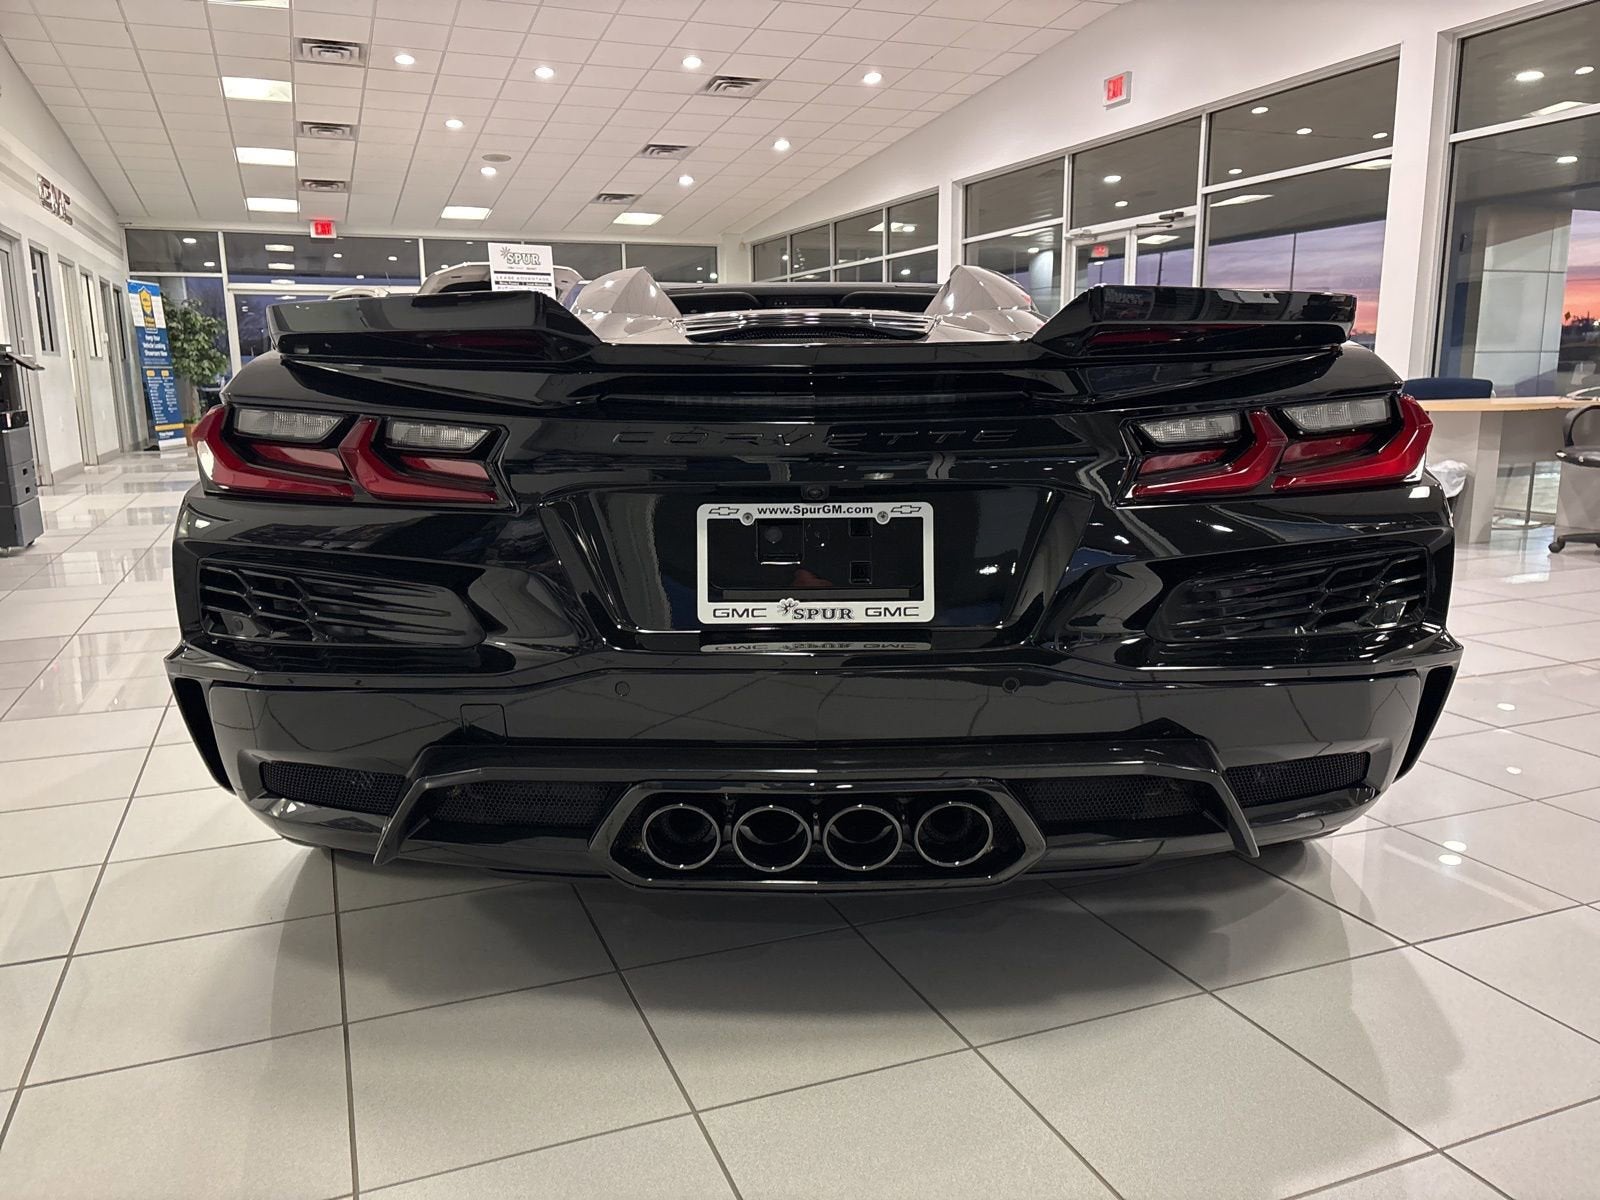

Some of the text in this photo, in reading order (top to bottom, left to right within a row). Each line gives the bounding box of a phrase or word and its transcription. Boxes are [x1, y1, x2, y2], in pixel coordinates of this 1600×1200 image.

[1107, 76, 1124, 101] EXIT
[37, 173, 73, 226] GMC
[315, 222, 332, 236] EXIT
[507, 252, 541, 265] SPUR
[612, 429, 1019, 447] CORVETTE
[757, 504, 874, 517] www.SpurGM.com
[712, 606, 920, 621] GMC SPUR GMC
